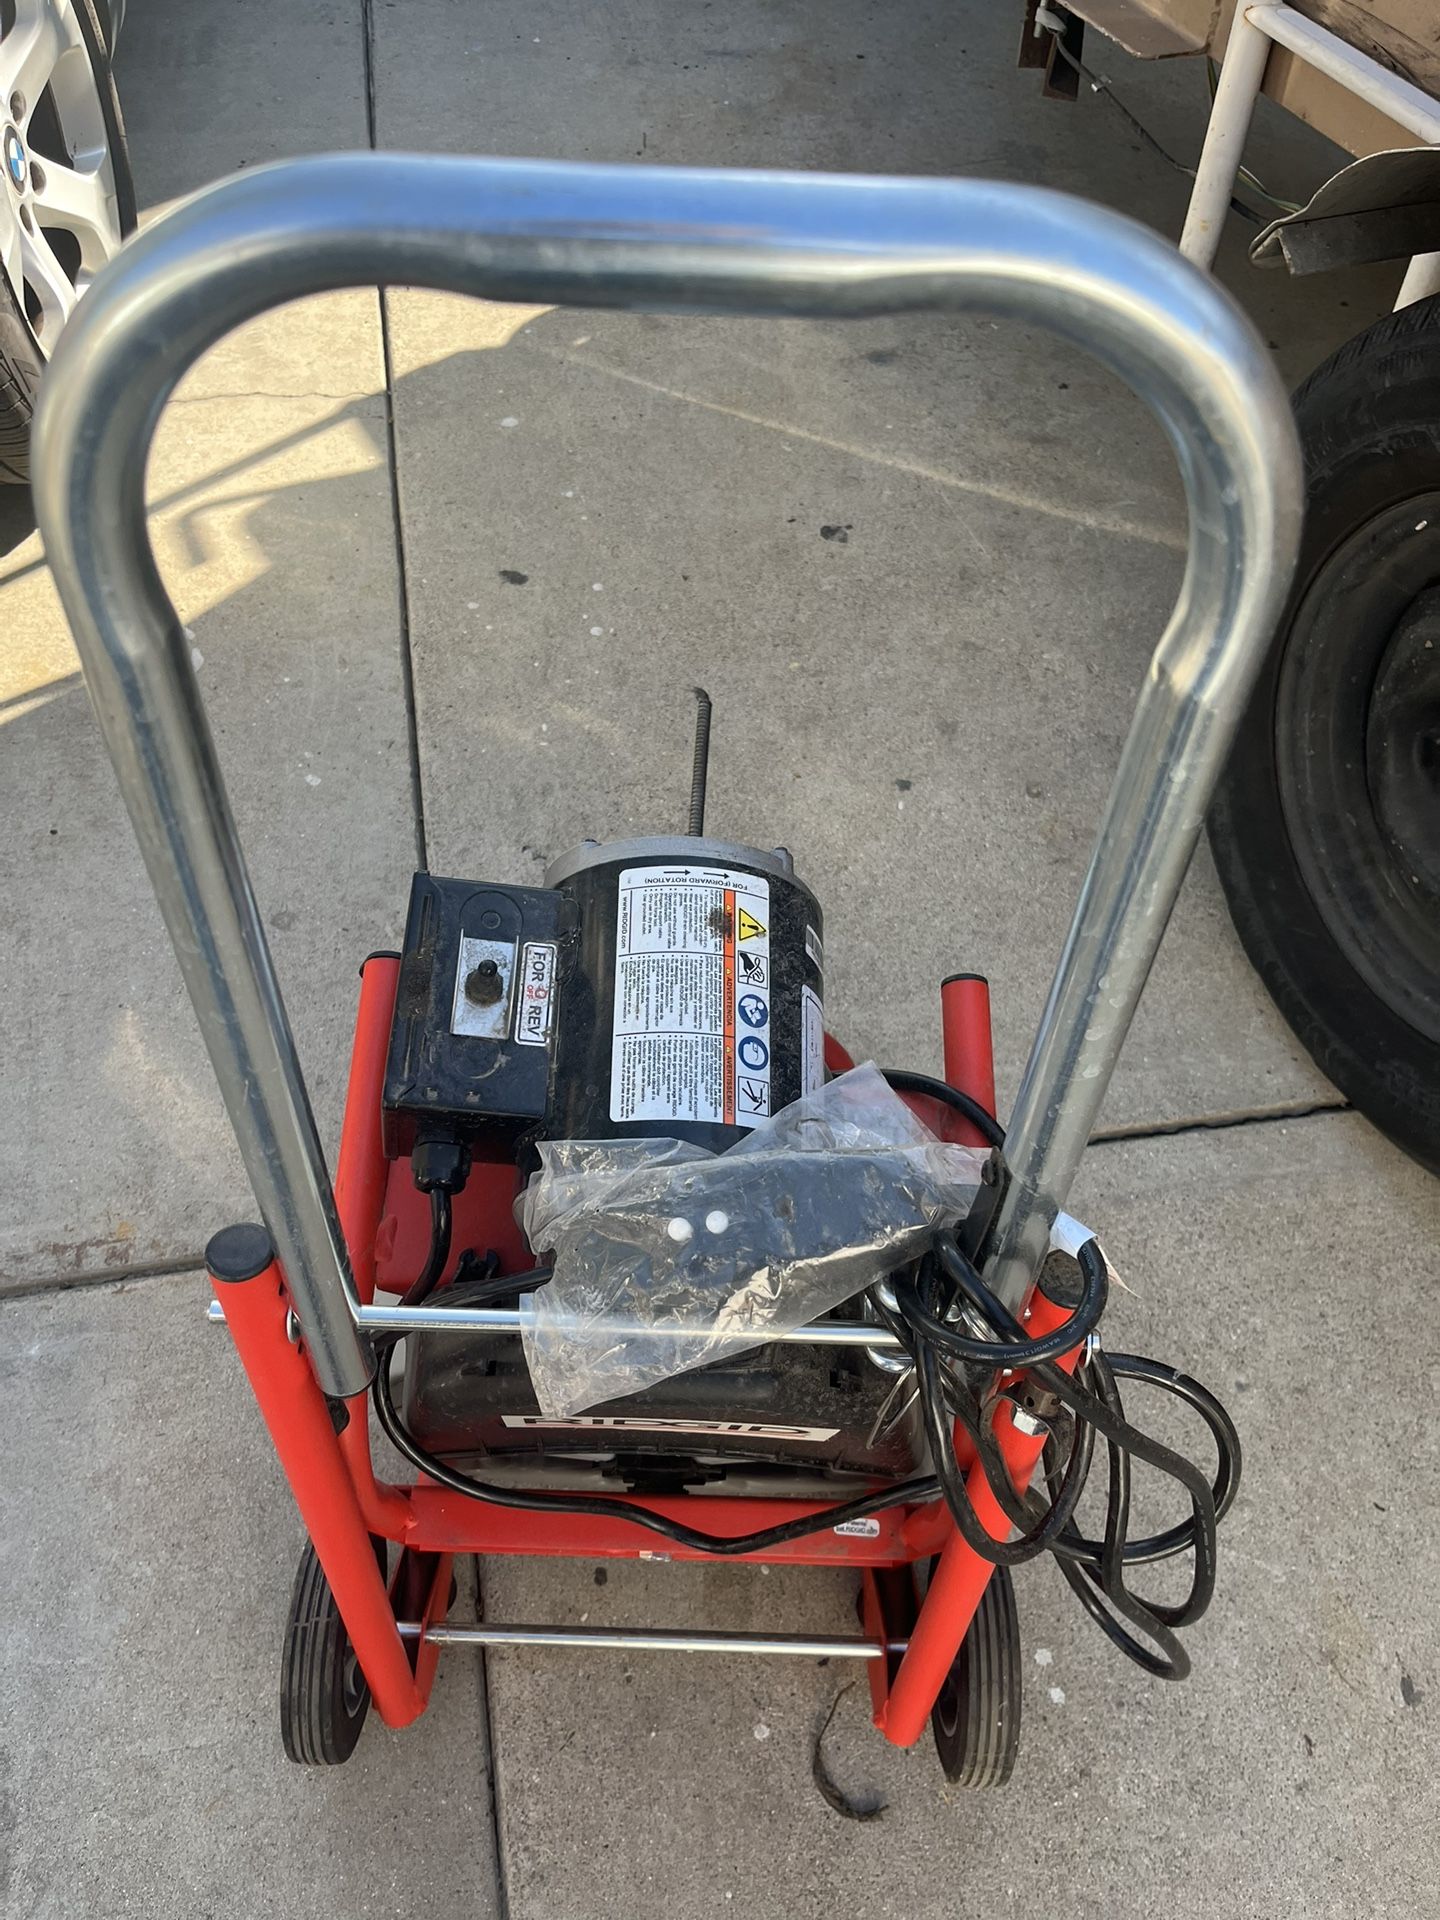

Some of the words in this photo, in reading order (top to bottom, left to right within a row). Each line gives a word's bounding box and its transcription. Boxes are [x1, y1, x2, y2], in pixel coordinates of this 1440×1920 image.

[689, 877, 731, 888] (FORWARD
[732, 882, 748, 890] FOR
[532, 951, 546, 982] FOR
[527, 1005, 542, 1036] REV
